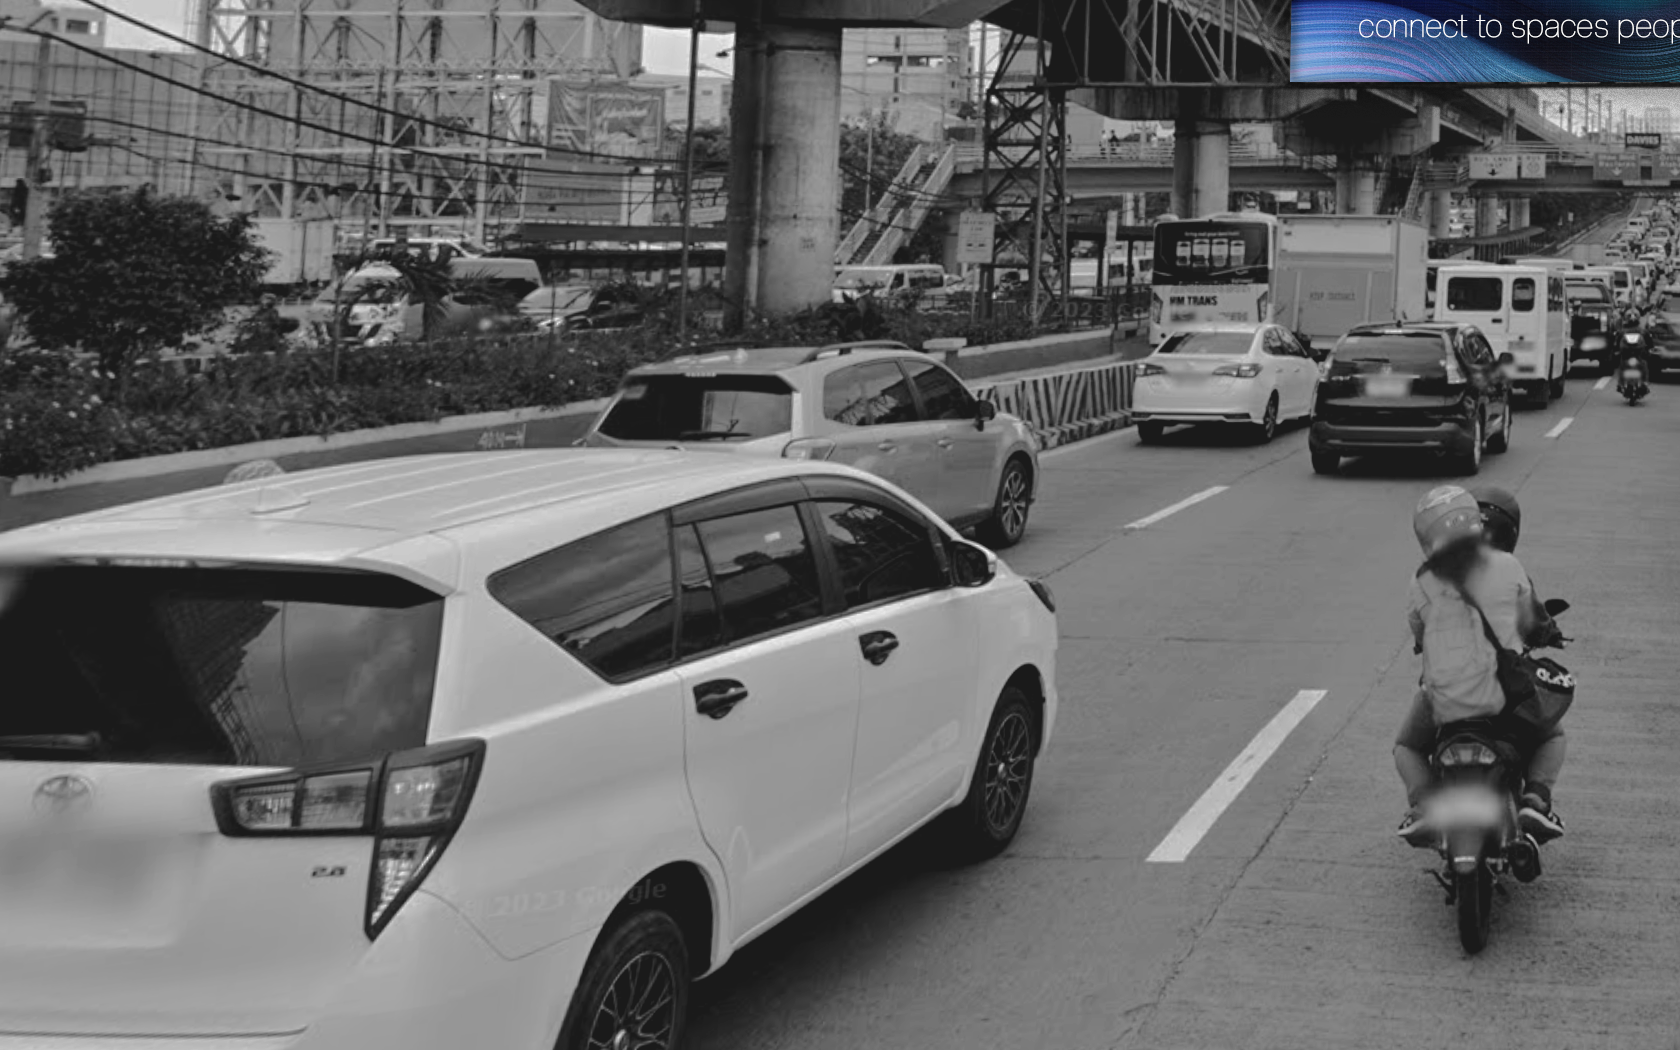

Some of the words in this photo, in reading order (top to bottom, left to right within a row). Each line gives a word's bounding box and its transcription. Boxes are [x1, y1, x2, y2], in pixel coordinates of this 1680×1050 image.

[1358, 14, 1468, 39] connect
[1475, 14, 1503, 39] to
[1511, 18, 1609, 44] spaces
[1626, 135, 1660, 145] DAVIES
[1187, 295, 1218, 306] TRANS
